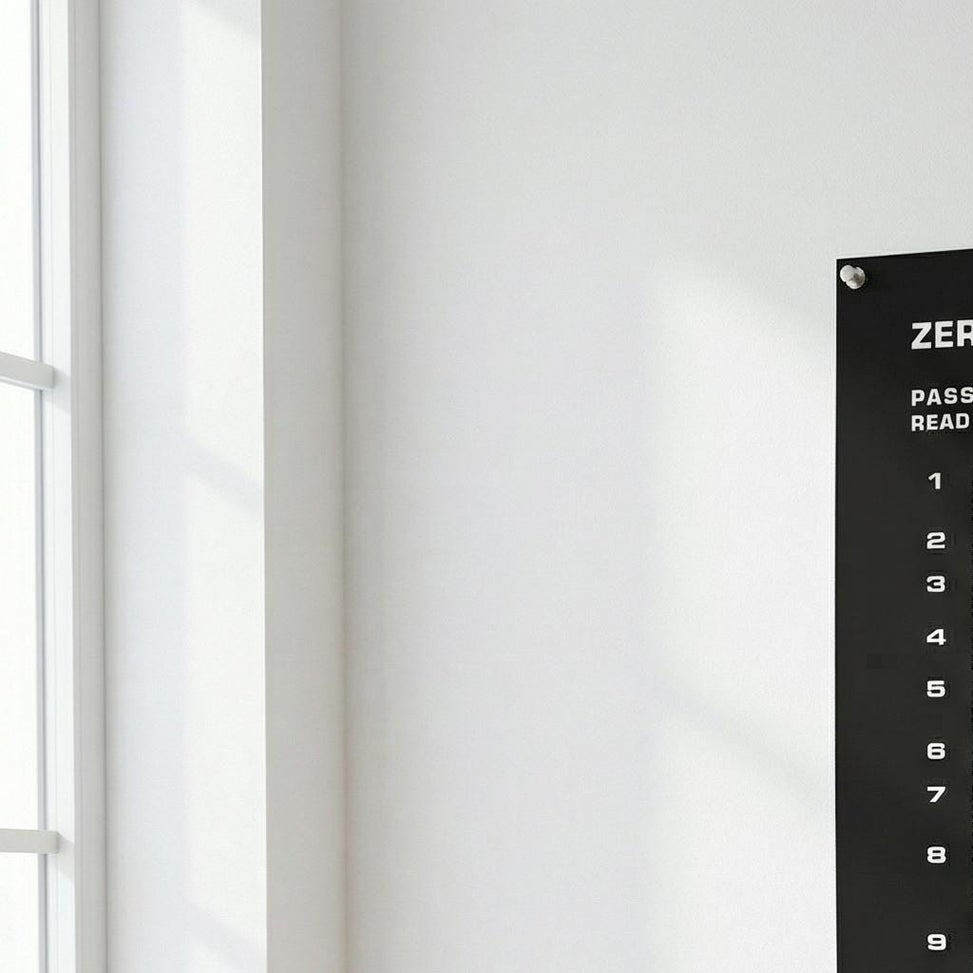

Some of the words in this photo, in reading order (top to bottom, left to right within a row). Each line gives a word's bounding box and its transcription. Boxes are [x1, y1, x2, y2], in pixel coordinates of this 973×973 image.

[912, 413, 969, 431] READ
[928, 473, 941, 489] 1
[927, 532, 945, 549] 2
[927, 576, 945, 592] 3
[927, 629, 946, 645] 4
[927, 680, 945, 697] 5
[927, 743, 945, 759] 6
[927, 786, 946, 802] 7
[927, 847, 946, 863] 8
[928, 934, 946, 950] 9
